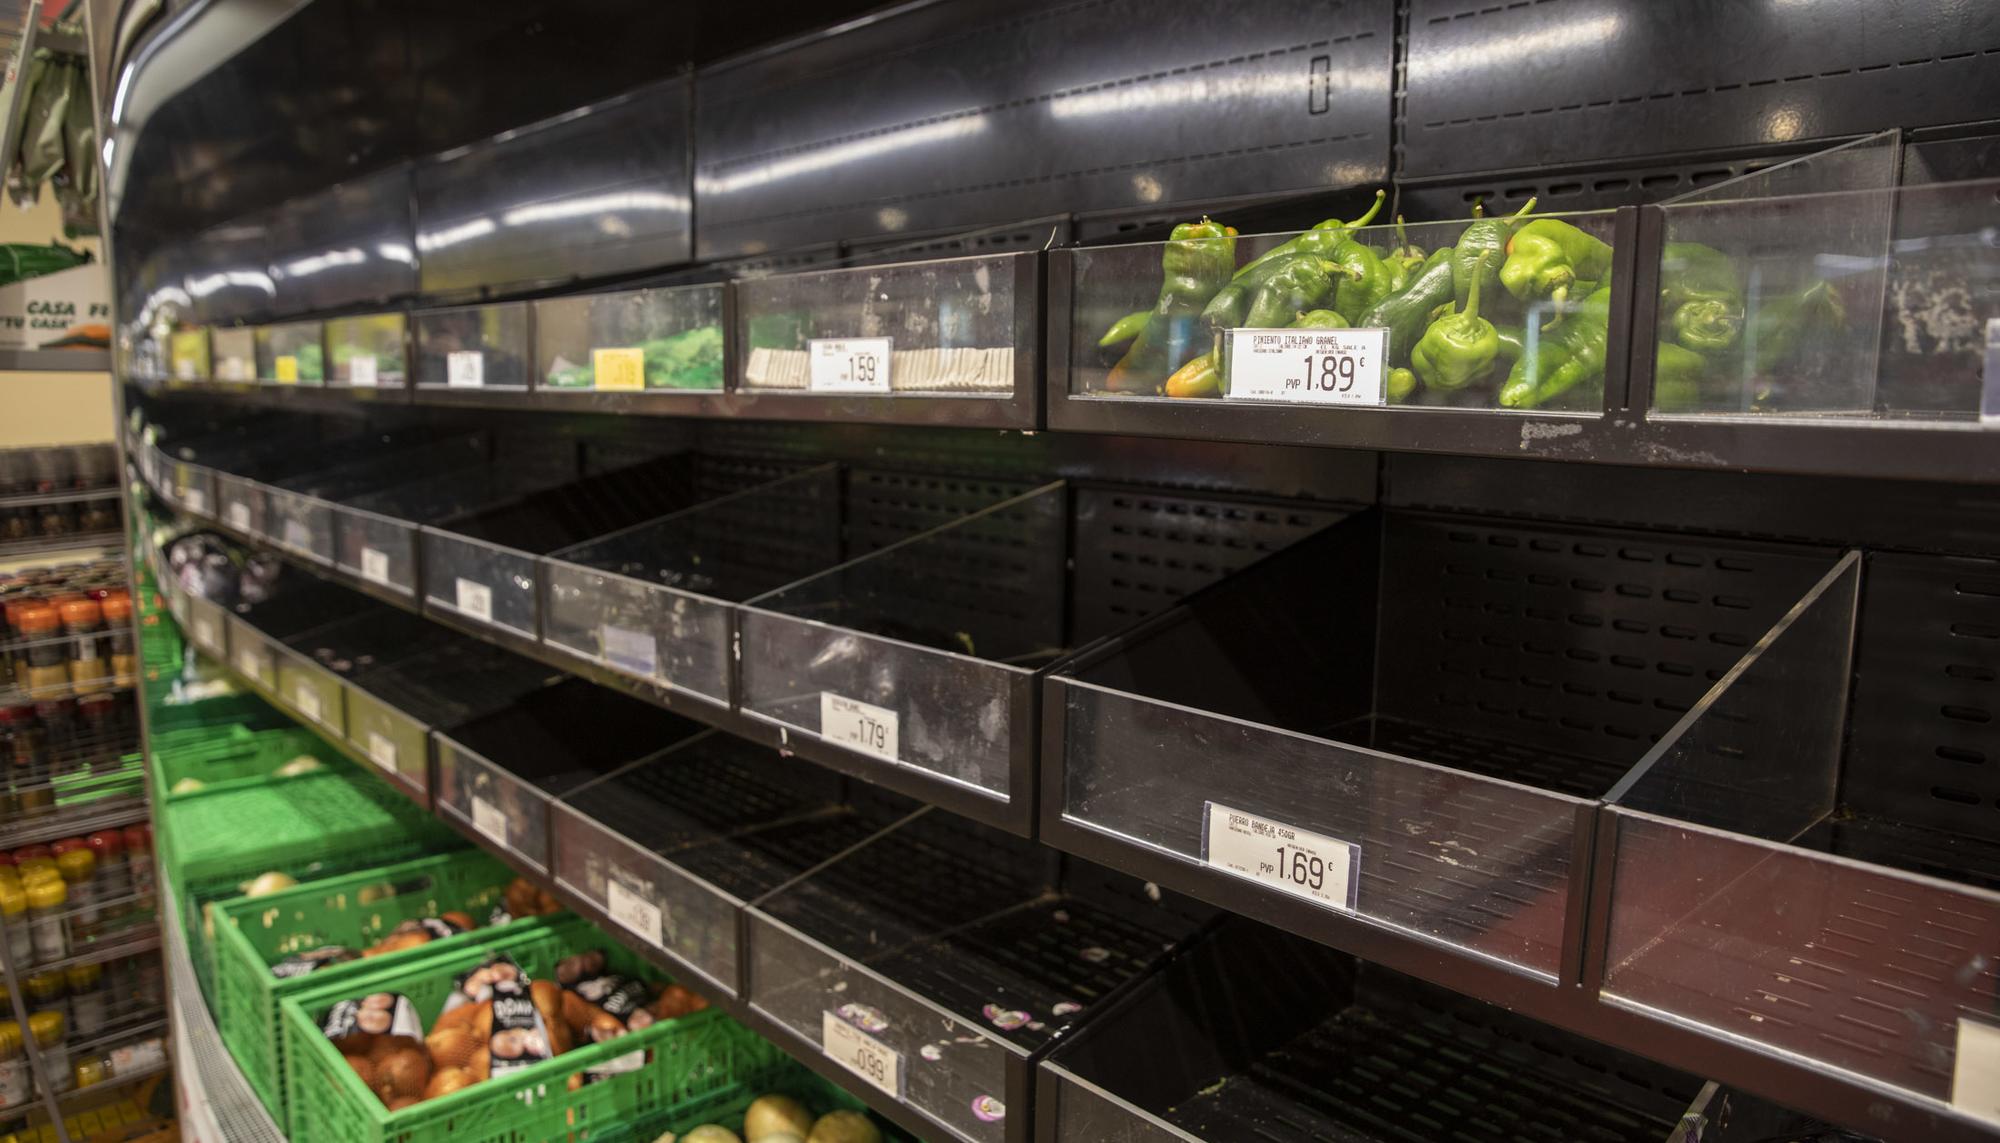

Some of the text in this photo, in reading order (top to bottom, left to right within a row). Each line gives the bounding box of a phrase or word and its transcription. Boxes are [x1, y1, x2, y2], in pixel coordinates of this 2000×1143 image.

[27, 301, 75, 315] CASA
[1253, 335, 1338, 346] PIMIENTO ITALIANO GRANEL
[1286, 378, 1300, 389] PVP
[1304, 355, 1355, 392] 1,89
[1229, 813, 1249, 827] PUERRO
[1251, 820, 1276, 834] BANDEJA
[1278, 828, 1295, 840] 450GR
[1260, 862, 1274, 874] PVP
[1276, 847, 1324, 890] 1,69
